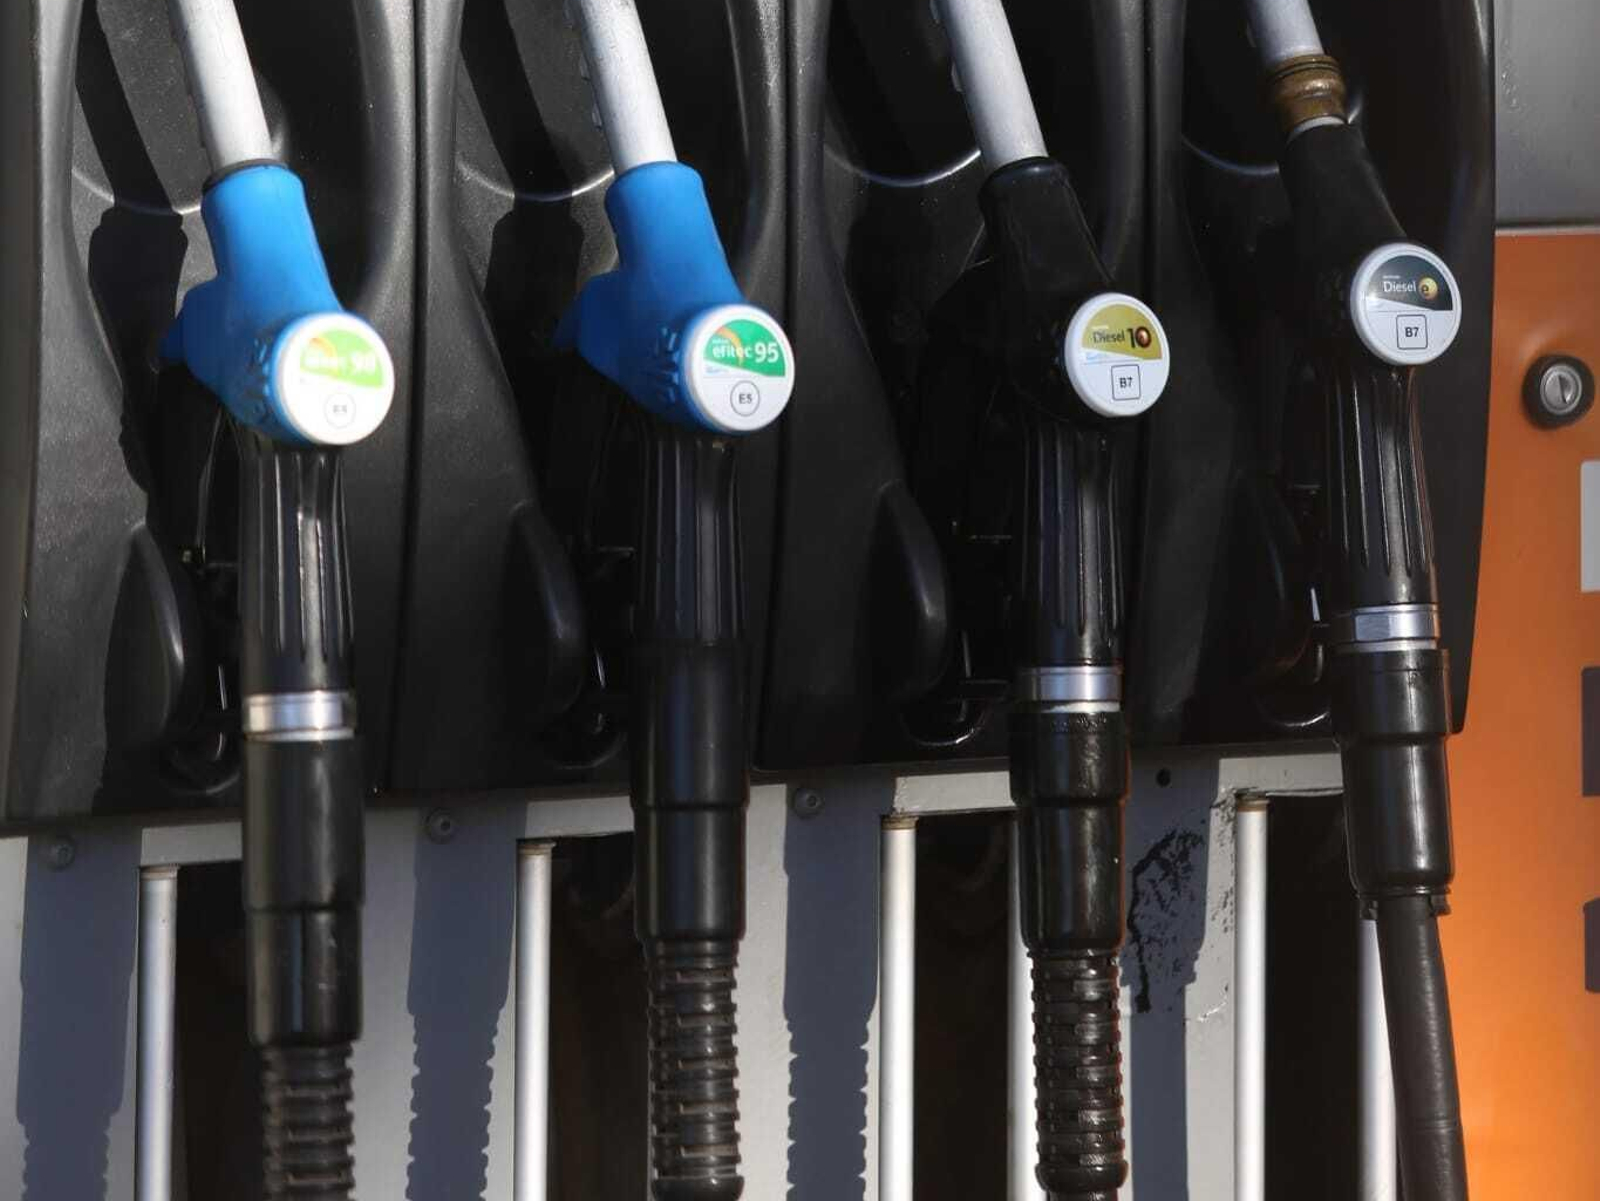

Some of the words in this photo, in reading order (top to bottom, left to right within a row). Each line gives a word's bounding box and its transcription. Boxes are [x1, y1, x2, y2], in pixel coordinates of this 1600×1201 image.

[1382, 281, 1417, 293] Diesel
[1093, 330, 1126, 344] Diesel
[1127, 326, 1152, 349] 10
[1404, 326, 1420, 338] B7
[754, 341, 780, 364] 95
[1119, 377, 1134, 389] B7
[738, 393, 753, 405] E5
